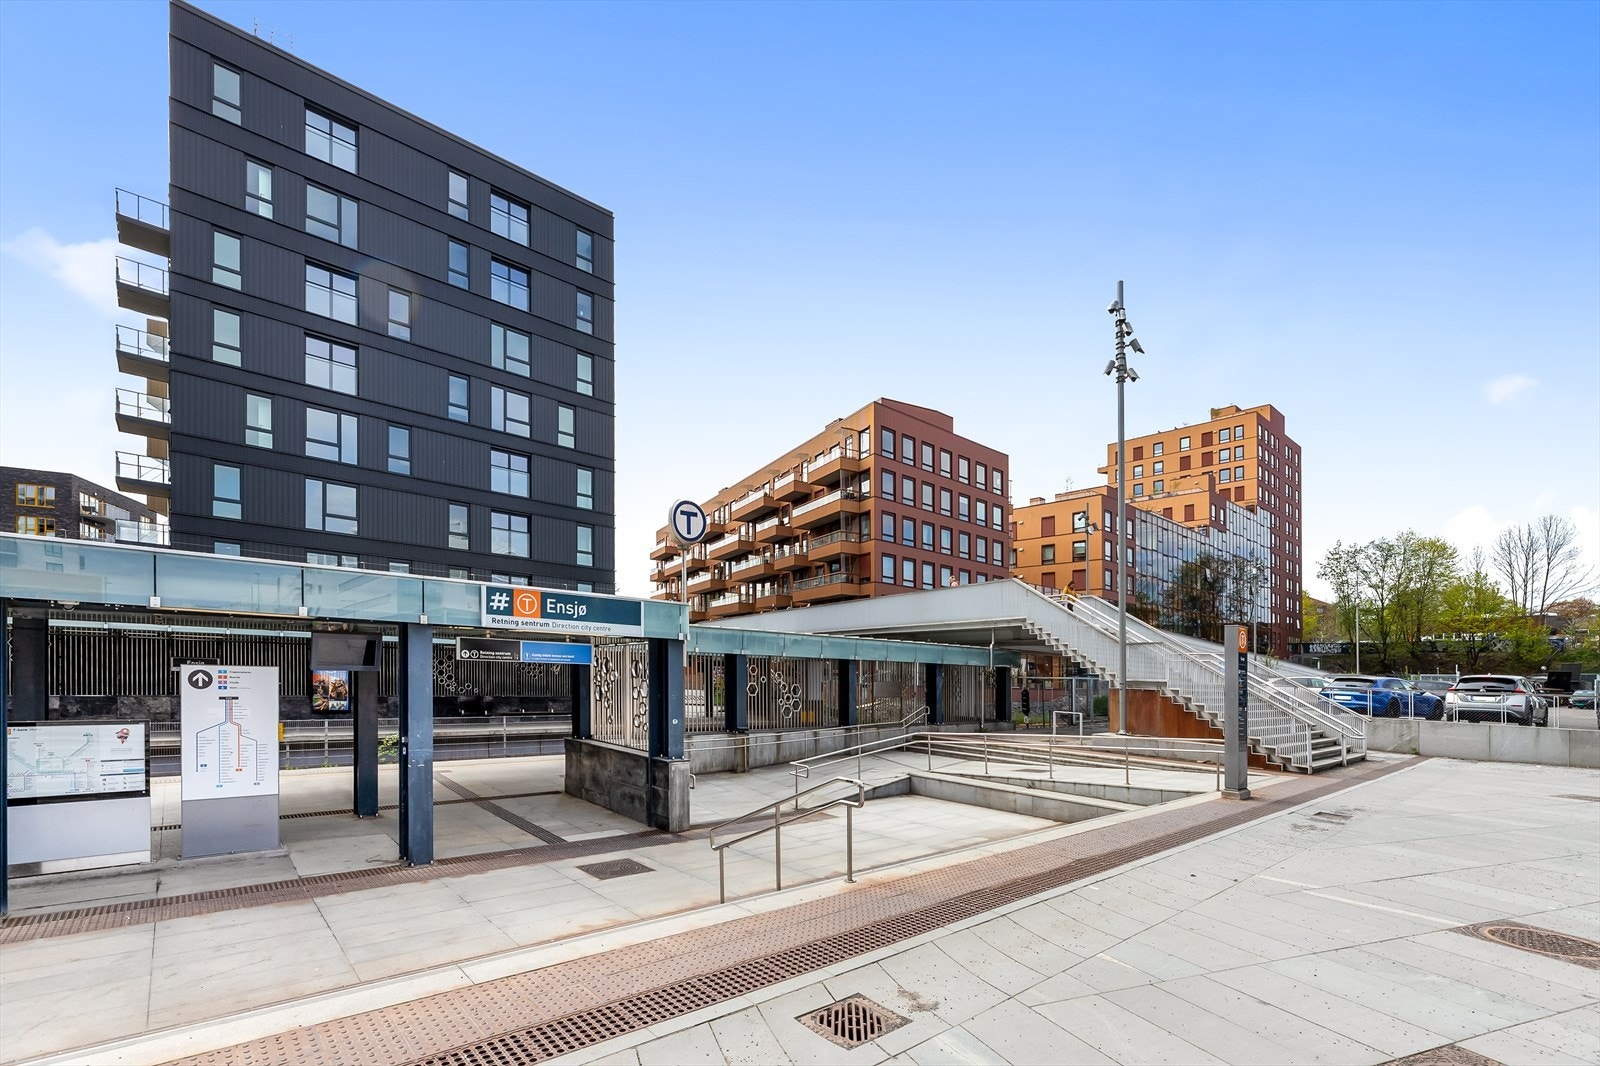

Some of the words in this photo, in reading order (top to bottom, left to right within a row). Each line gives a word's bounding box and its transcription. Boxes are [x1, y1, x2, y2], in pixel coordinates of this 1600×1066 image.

[680, 510, 698, 535] T
[522, 598, 533, 612] T
[546, 598, 587, 618] Ensjø
[491, 617, 519, 627] Retning
[521, 620, 550, 628] sentrum
[552, 621, 579, 630] Direction
[581, 624, 592, 632] city
